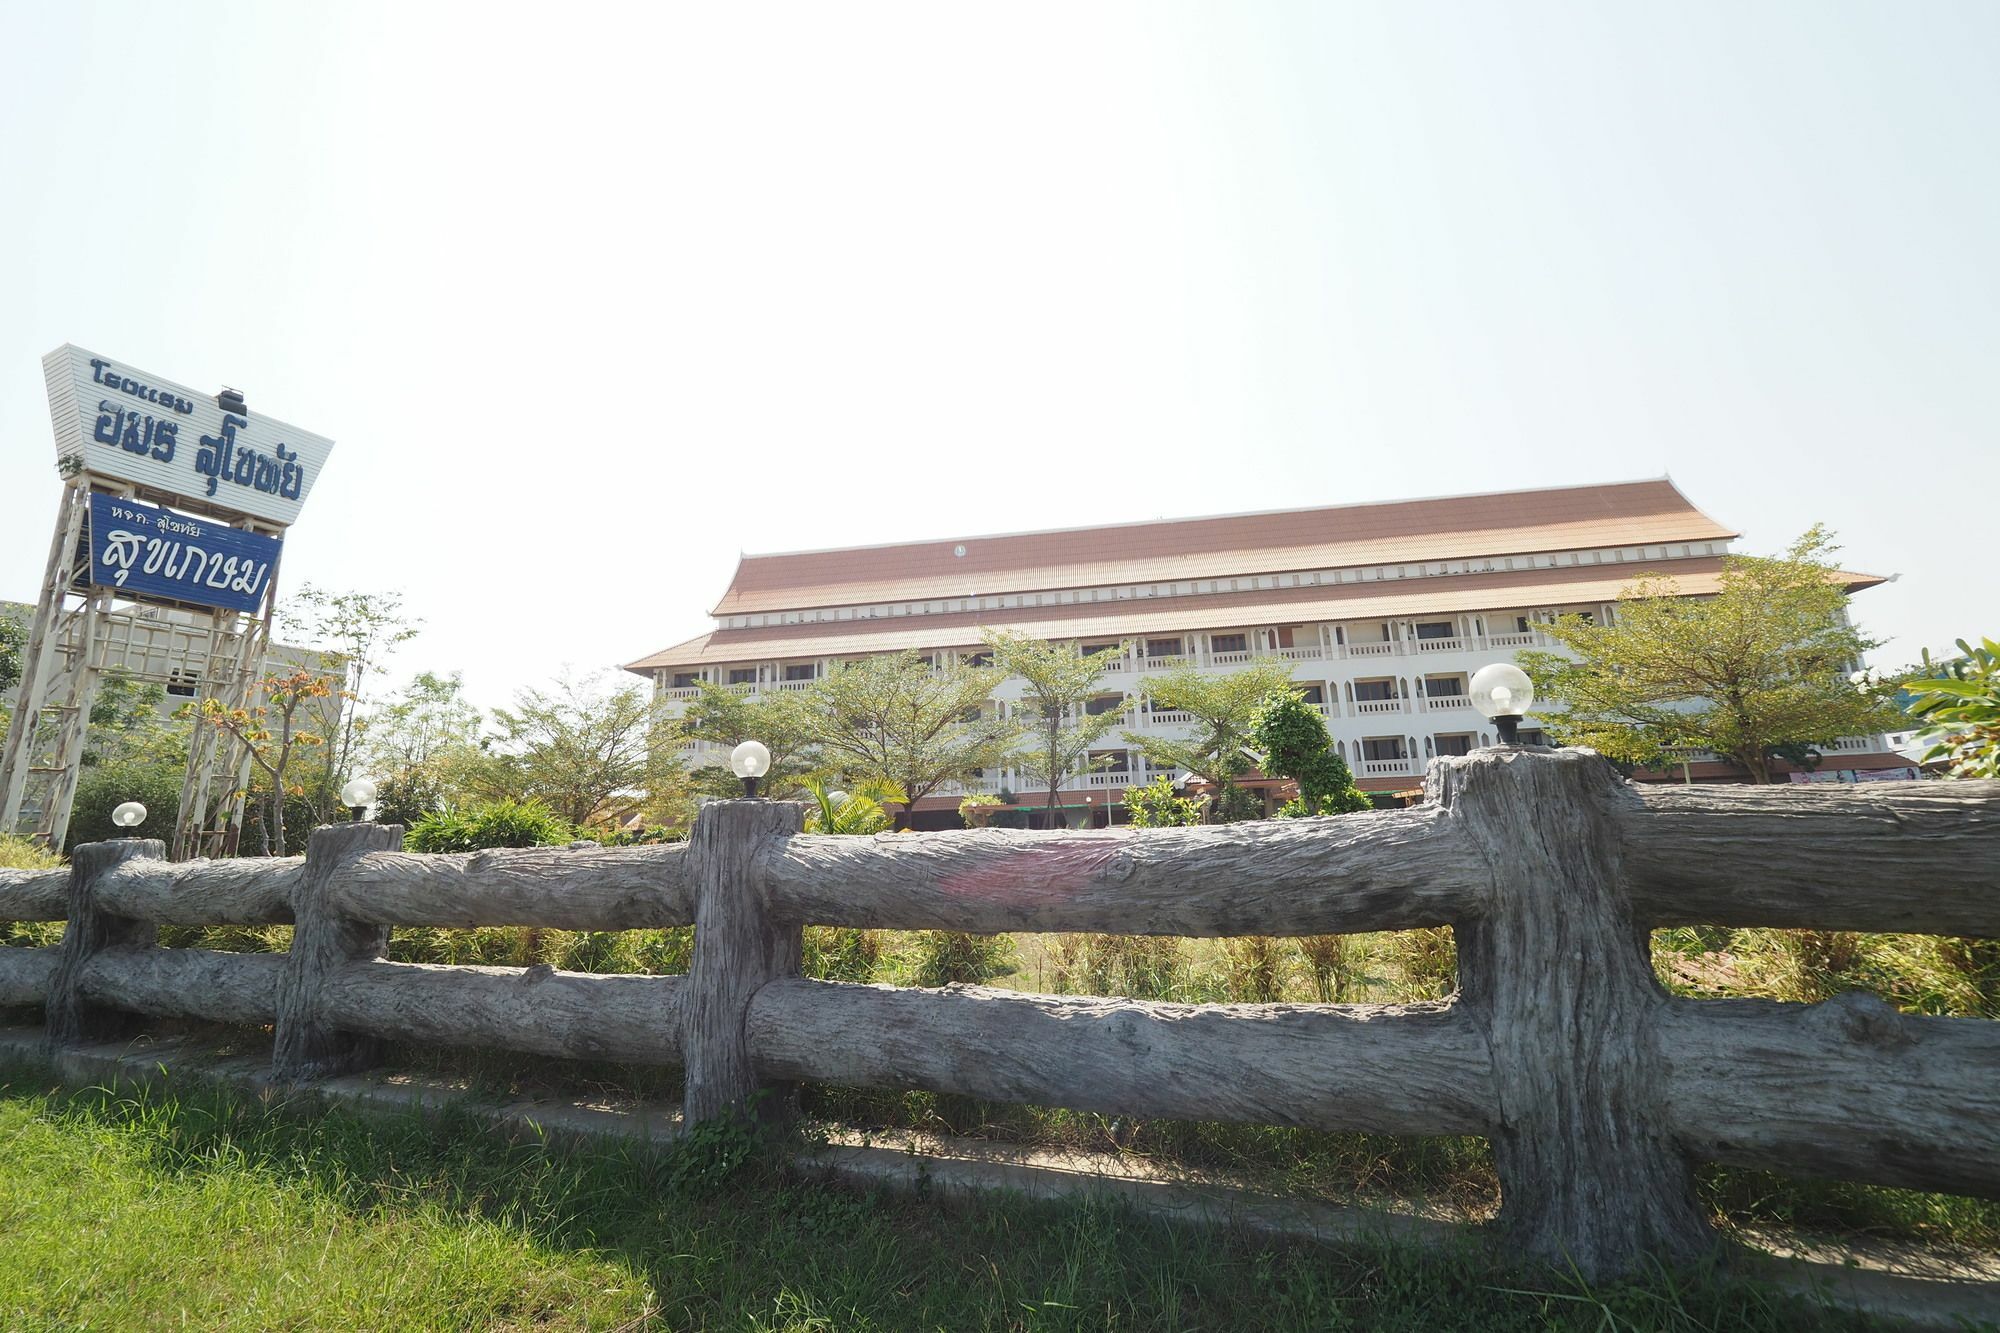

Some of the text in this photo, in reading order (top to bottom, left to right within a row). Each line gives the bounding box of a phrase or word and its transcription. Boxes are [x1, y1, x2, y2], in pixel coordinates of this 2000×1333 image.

[90, 358, 193, 415] โรงแรม
[195, 413, 304, 500] สุโขทัย
[157, 515, 201, 537] สุโขทัย
[102, 530, 267, 594] สุขเกษม
